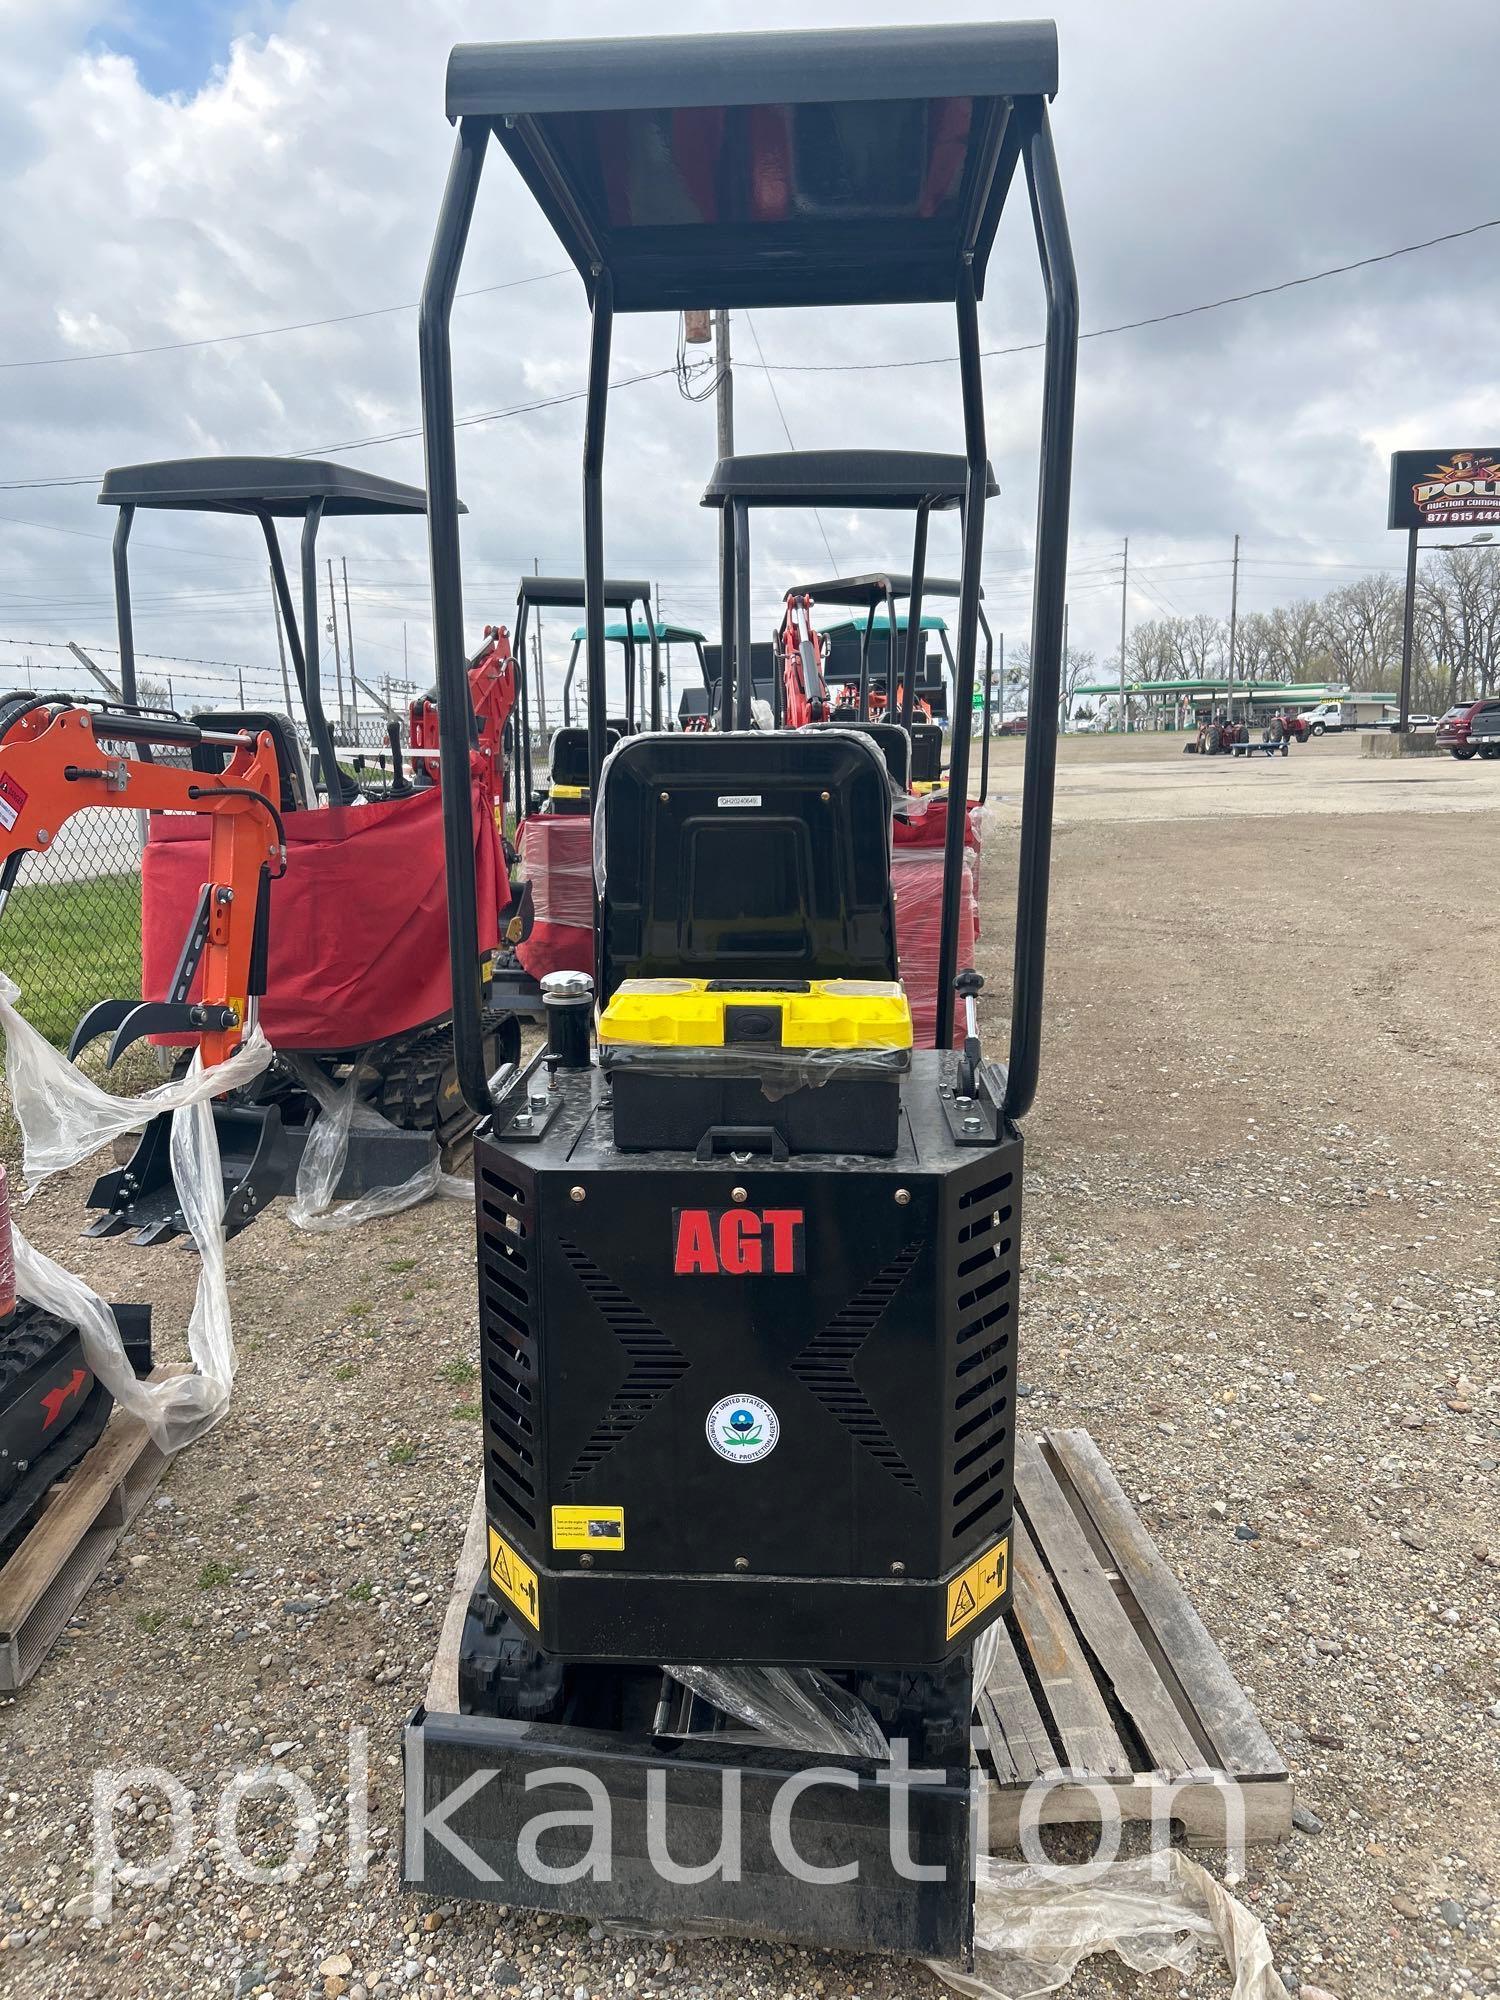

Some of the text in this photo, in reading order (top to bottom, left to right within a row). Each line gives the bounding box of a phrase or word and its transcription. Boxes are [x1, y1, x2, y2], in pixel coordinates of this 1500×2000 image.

[1427, 513, 1448, 522] 877
[1451, 512, 1473, 521] 915
[674, 1208, 804, 1275] AGT
[719, 1397, 765, 1410] UNITED STATES
[709, 1413, 776, 1460] ENVIRONMENTAL PROTECTION AGENCY
